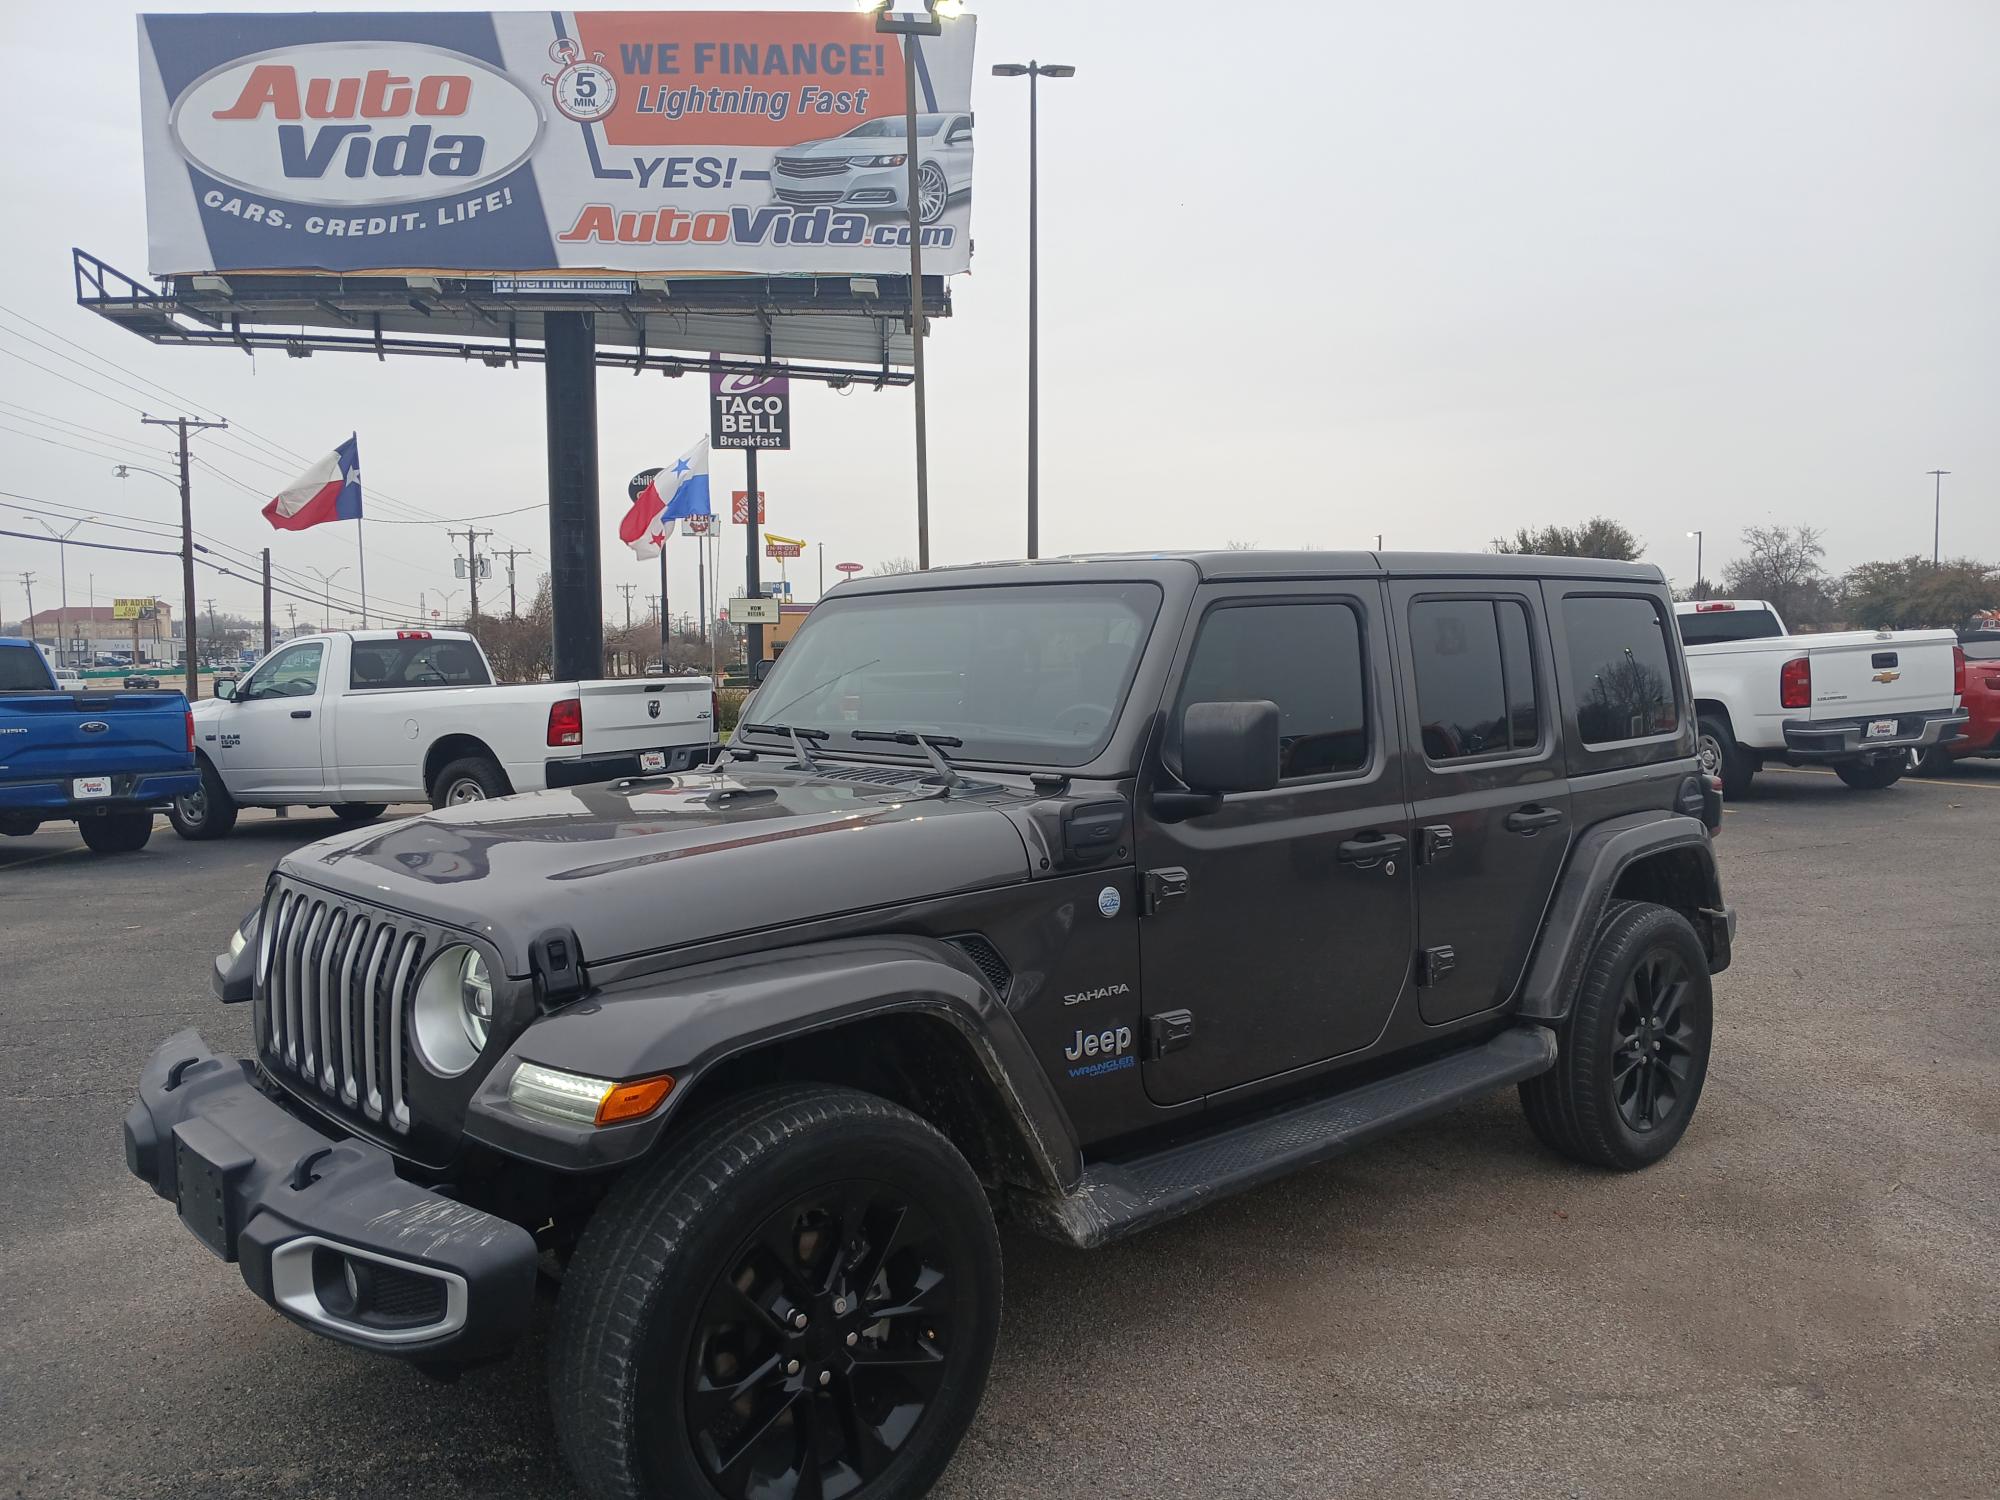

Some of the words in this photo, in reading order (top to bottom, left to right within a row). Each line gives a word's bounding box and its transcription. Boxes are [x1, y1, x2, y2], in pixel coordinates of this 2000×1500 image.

[620, 43, 680, 75] WE
[694, 43, 885, 76] FINANCE!
[212, 65, 472, 119] Auto
[575, 73, 597, 98] 5
[574, 98, 599, 107] MIN.
[636, 86, 789, 121] Lightning
[797, 87, 868, 115] Fast
[278, 125, 486, 178] Vida
[632, 157, 738, 189] YES!
[203, 190, 293, 229] CARS.
[305, 213, 426, 236] CREDIT.
[438, 187, 513, 226] LIFE!
[558, 205, 955, 247] AutoVida.com
[716, 396, 783, 415] TACO
[721, 415, 782, 433] BELL
[719, 435, 781, 447] Breakfast
[114, 599, 128, 607] JIM
[1063, 983, 1130, 1006] SAHARA
[1065, 1026, 1132, 1061] Jeep
[1068, 1055, 1134, 1077] WRANGLER
